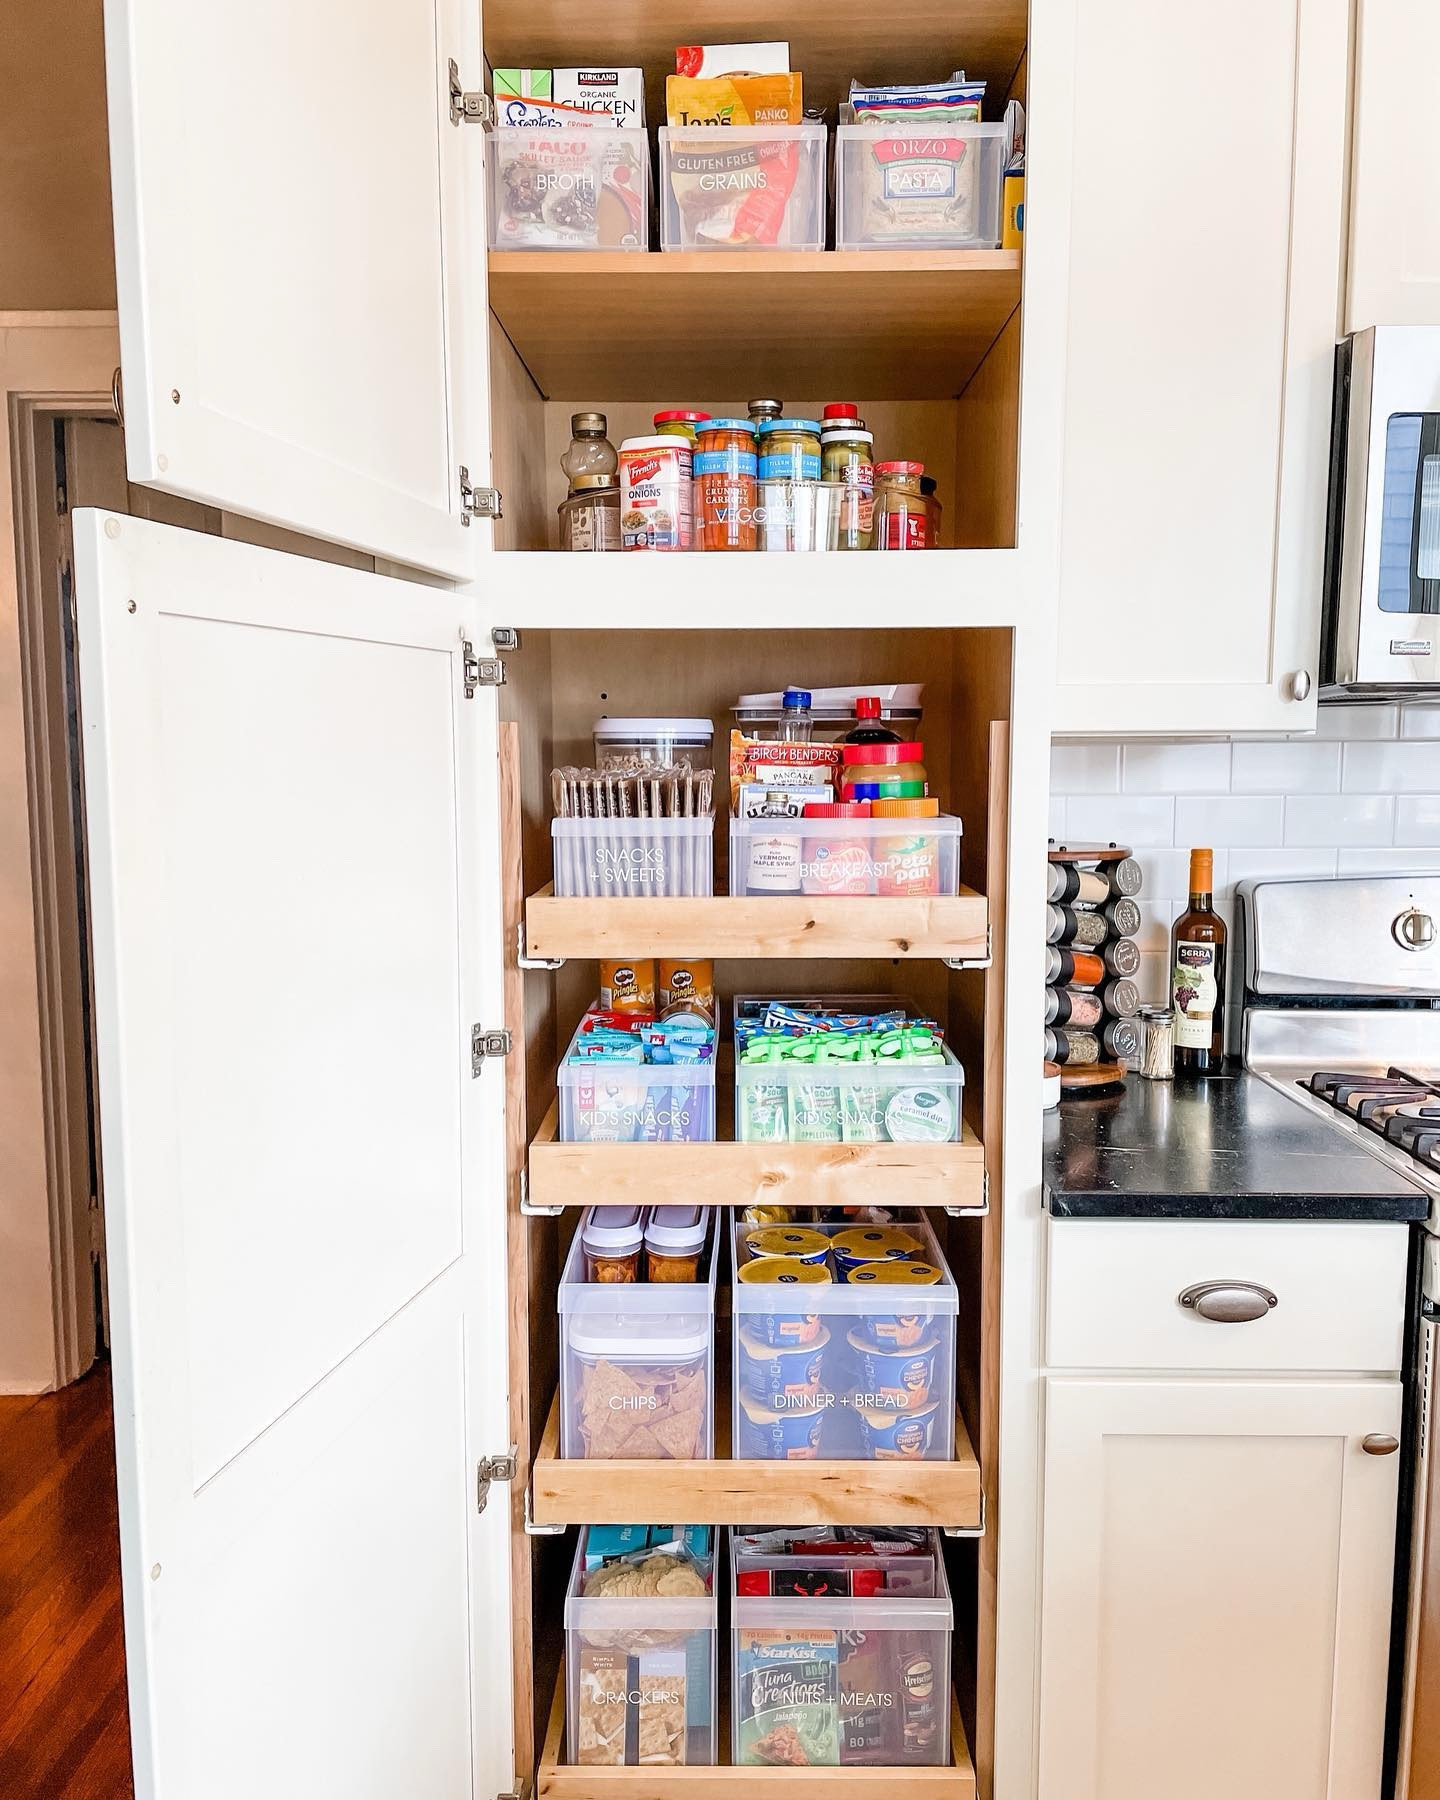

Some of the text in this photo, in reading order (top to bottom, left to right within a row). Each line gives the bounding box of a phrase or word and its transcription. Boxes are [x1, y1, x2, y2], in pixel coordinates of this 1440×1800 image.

[579, 72, 617, 81] KIRKLAND
[579, 91, 617, 99] ORGANIC
[754, 109, 789, 121] PANKO
[893, 140, 947, 156] ORZO
[677, 151, 756, 171] GLUTEN FREE
[537, 174, 594, 190] BROTH
[699, 173, 768, 191] GRAINS
[888, 172, 944, 189] PASTA
[631, 460, 658, 478] French's
[628, 489, 661, 499] ONIONS
[705, 496, 748, 504] CARROTS
[750, 748, 839, 763] BIRCH BENDERS
[773, 772, 814, 781] PANCAKE
[596, 849, 664, 863] SNACKS
[888, 854, 933, 870] Peter
[591, 868, 665, 882] + SWEETS
[800, 863, 889, 877] BREAKFAST
[1181, 949, 1211, 958] SERRA
[613, 983, 639, 999] Pringles
[671, 985, 696, 1002] Pringles
[580, 1111, 690, 1125] KID'S SNACKS
[794, 1111, 903, 1125] KID'S SNACKS
[900, 1106, 943, 1123] caramel dip
[609, 1396, 657, 1410] CHIPS
[775, 1394, 909, 1408] DINNER + BREAD
[760, 1647, 817, 1659] StarKist
[758, 1669, 792, 1688] Tuna
[593, 1691, 679, 1704] CRACKERS
[751, 1681, 827, 1707] Creations
[783, 1691, 893, 1707] NUTS + MEATS
[849, 1736, 865, 1748] 80
